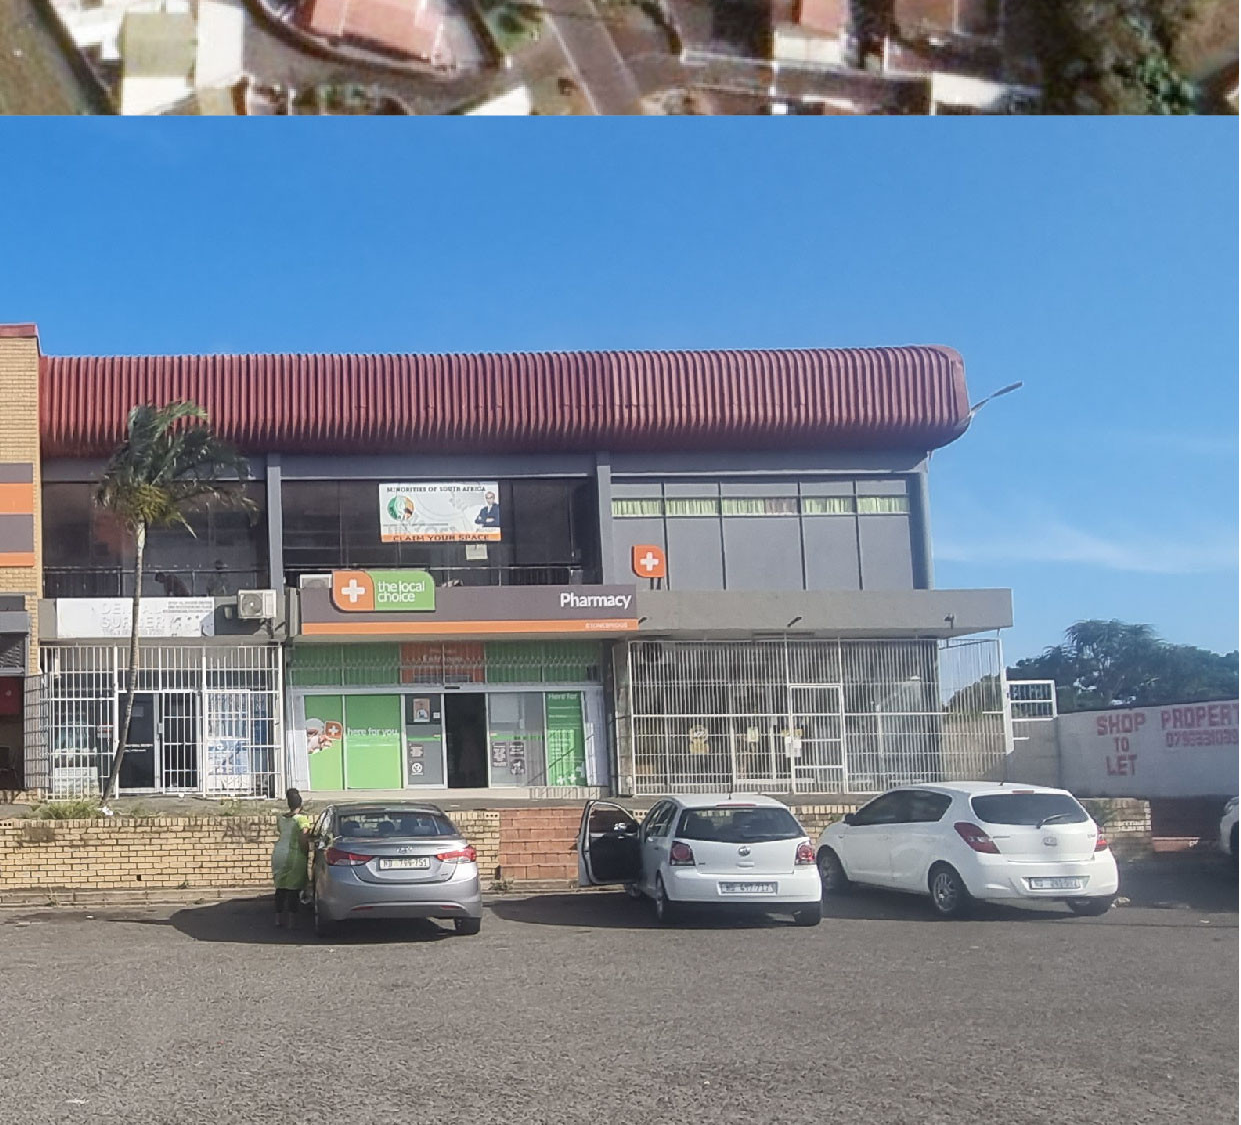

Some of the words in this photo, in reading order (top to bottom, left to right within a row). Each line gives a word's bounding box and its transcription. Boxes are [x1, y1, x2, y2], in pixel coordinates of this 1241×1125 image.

[394, 534, 425, 542] CLAIM
[429, 534, 457, 542] YOUR
[378, 581, 397, 592] the
[399, 580, 426, 593] local
[377, 591, 416, 603] choice
[560, 592, 633, 610] Pharmacy
[347, 727, 367, 736] here
[368, 726, 380, 736] for
[1096, 712, 1146, 736] SHOP
[1113, 737, 1130, 752] TO
[1106, 754, 1137, 776] LET
